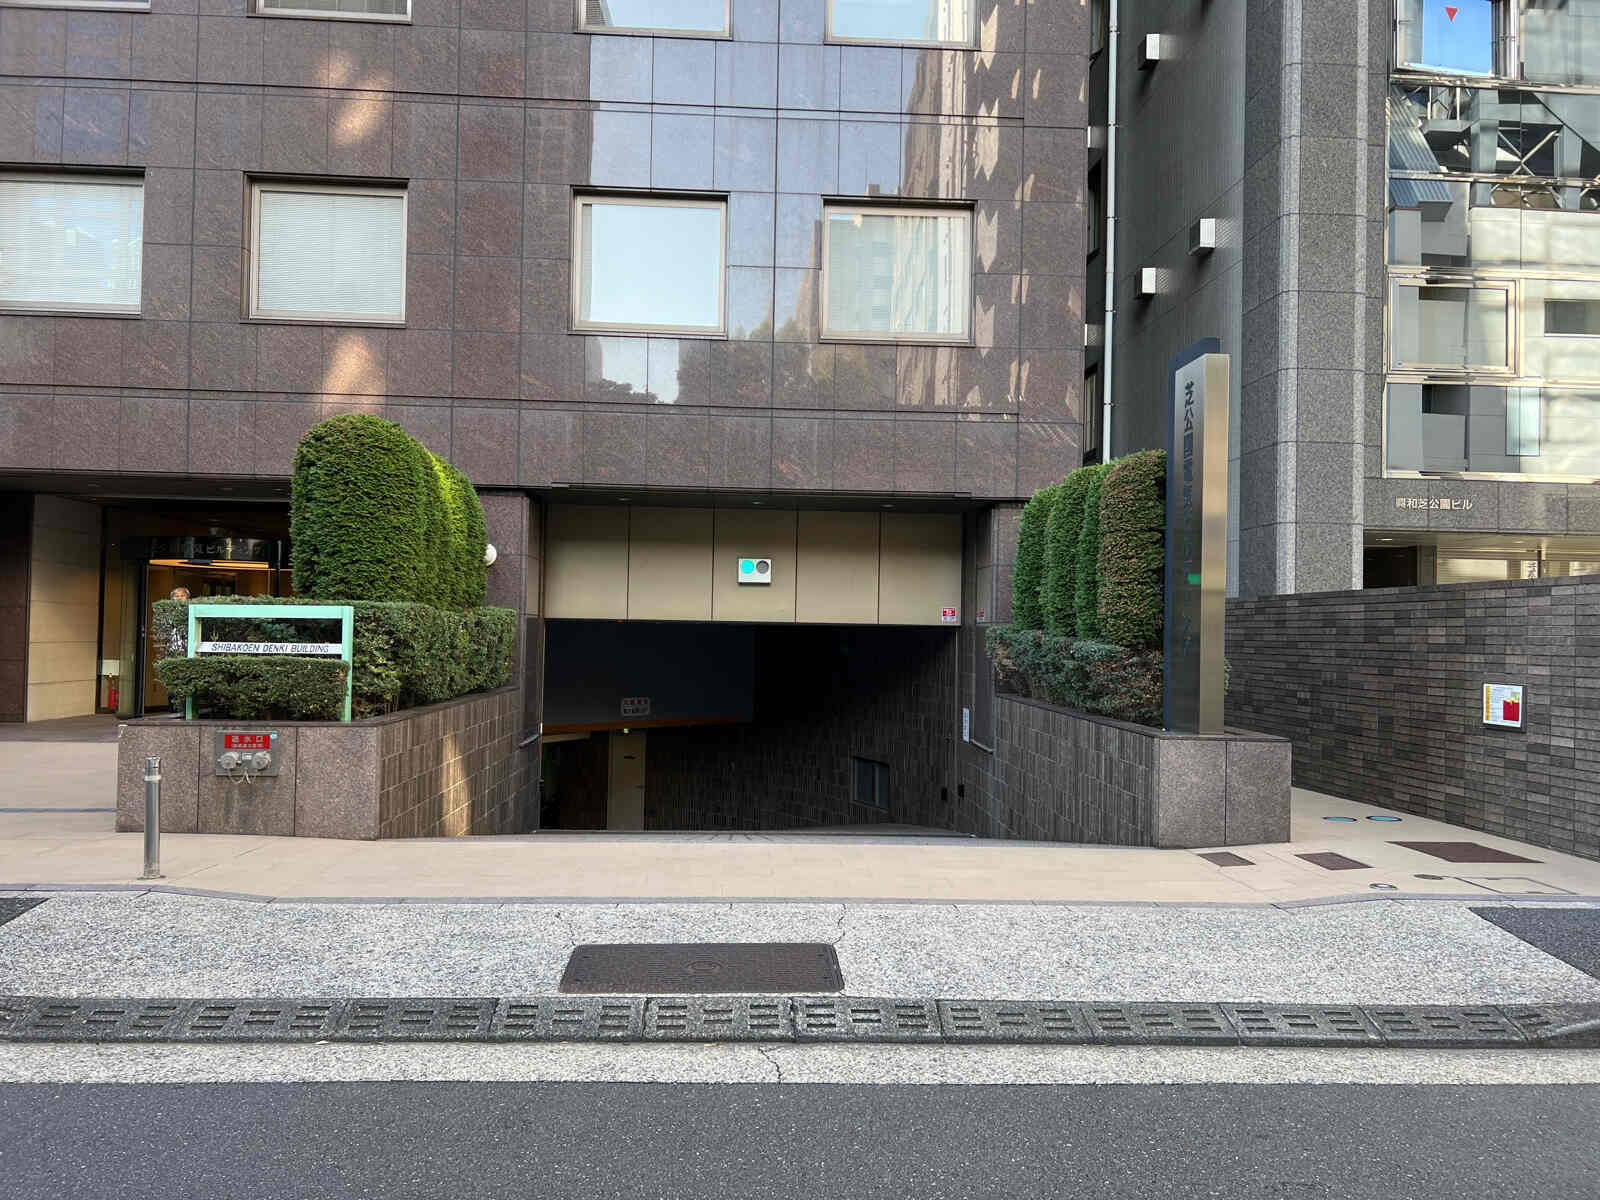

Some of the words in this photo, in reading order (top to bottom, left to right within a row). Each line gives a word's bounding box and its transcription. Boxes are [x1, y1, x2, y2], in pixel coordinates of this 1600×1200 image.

[211, 643, 259, 652] SHIBAKOEN
[262, 644, 288, 653] DENKI
[290, 645, 329, 654] BUILDING
